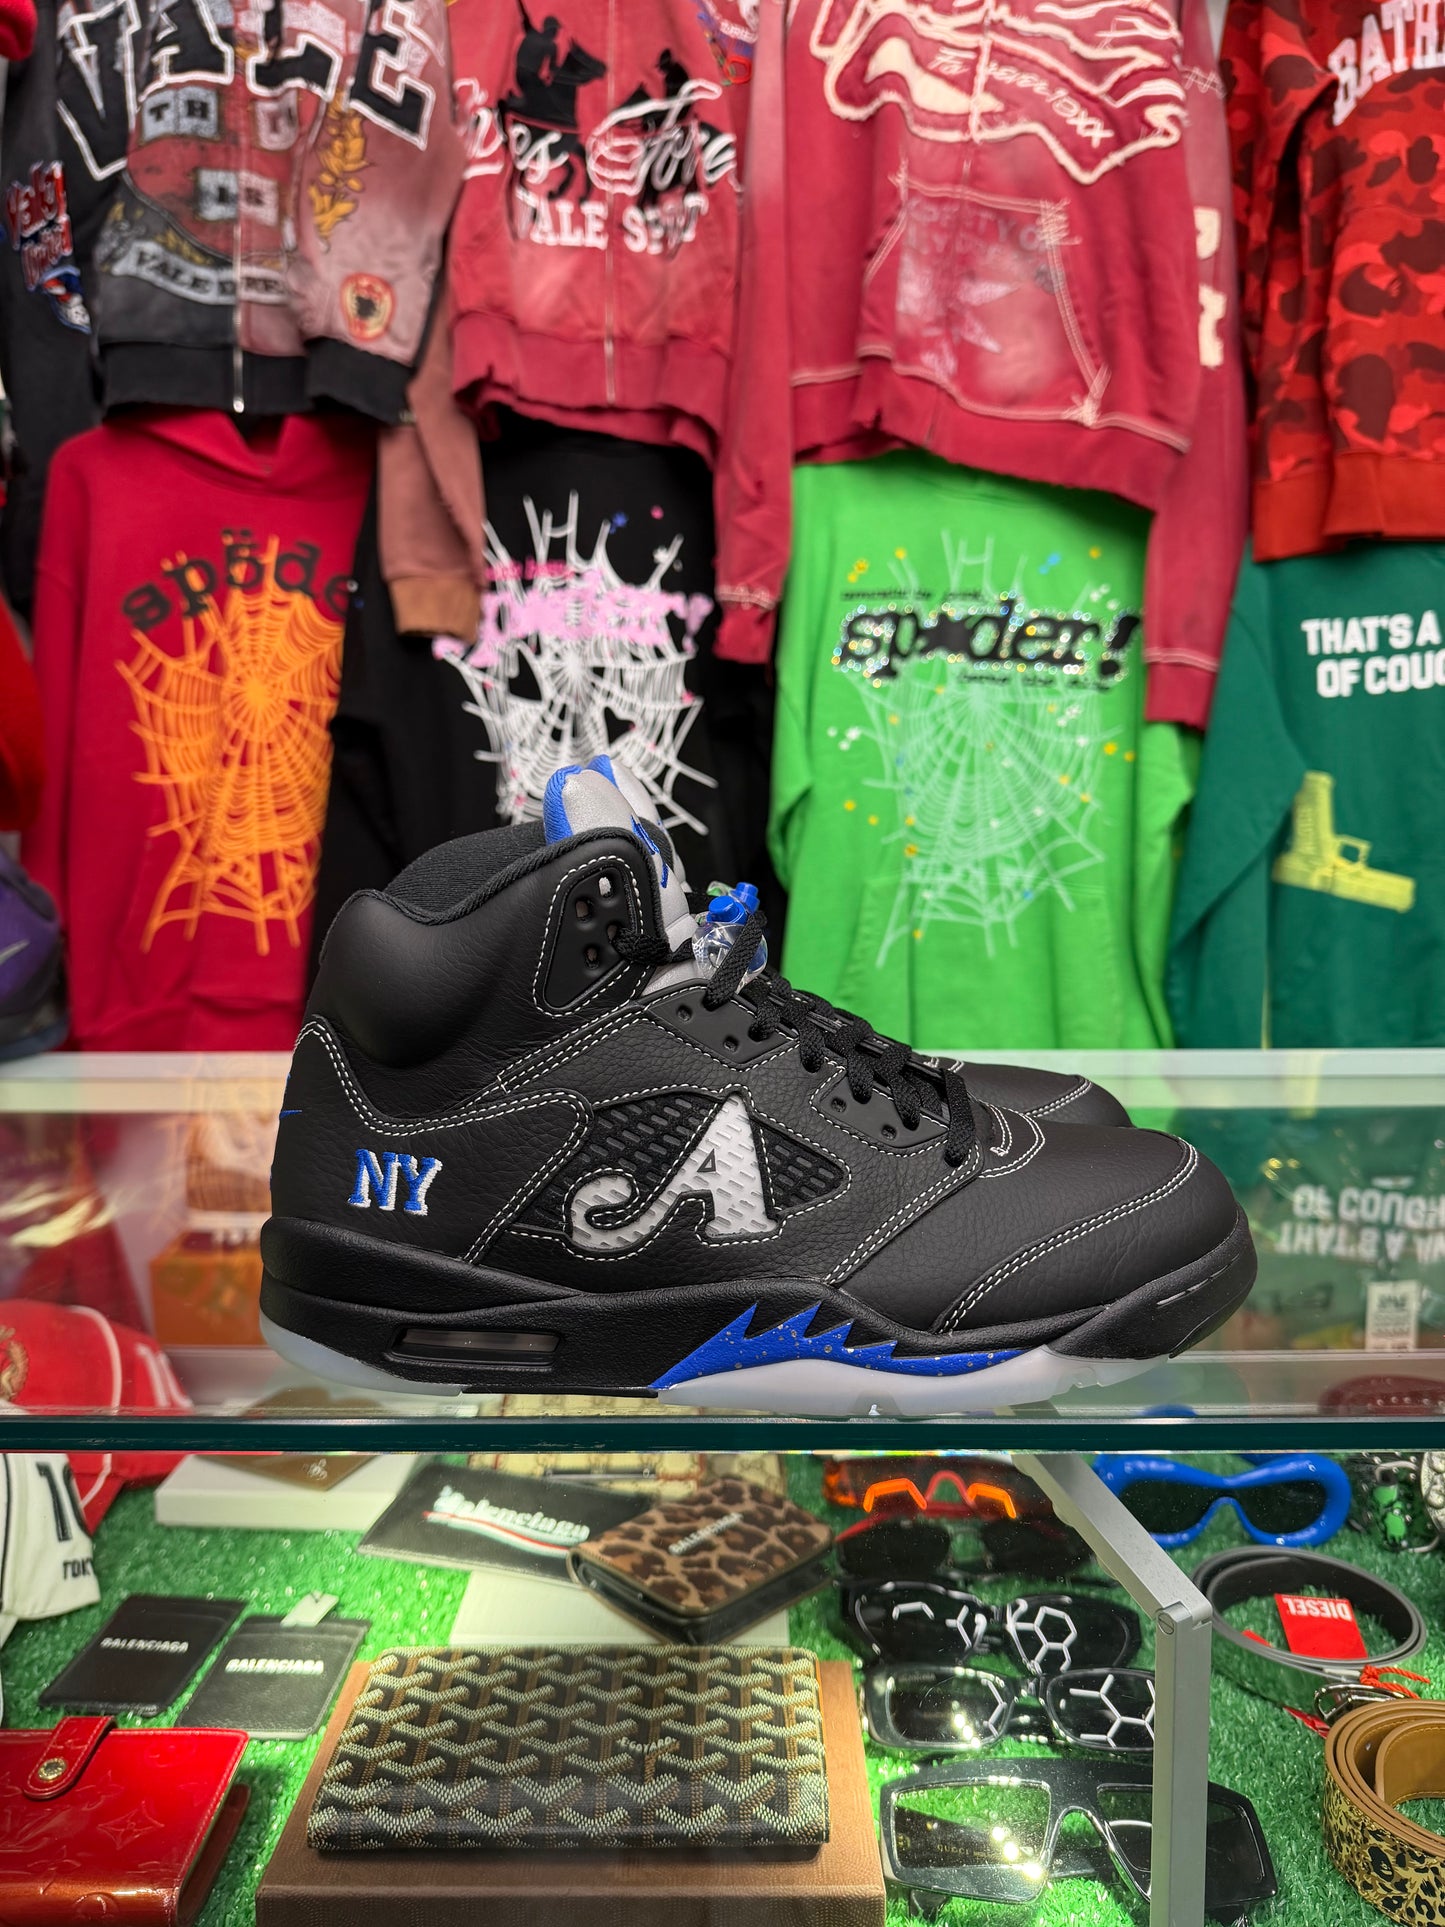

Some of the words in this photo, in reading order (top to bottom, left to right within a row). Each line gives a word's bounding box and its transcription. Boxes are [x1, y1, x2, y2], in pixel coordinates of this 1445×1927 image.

[1328, 0, 1445, 126] BATH
[1301, 612, 1414, 656] THAT'S
[1415, 609, 1443, 647] A
[1316, 658, 1363, 699] OF
[348, 1149, 443, 1217] NY
[1281, 1597, 1353, 1622] DIESEL
[899, 1789, 928, 1801] GUCCI
[937, 1844, 970, 1856] GUCCI
